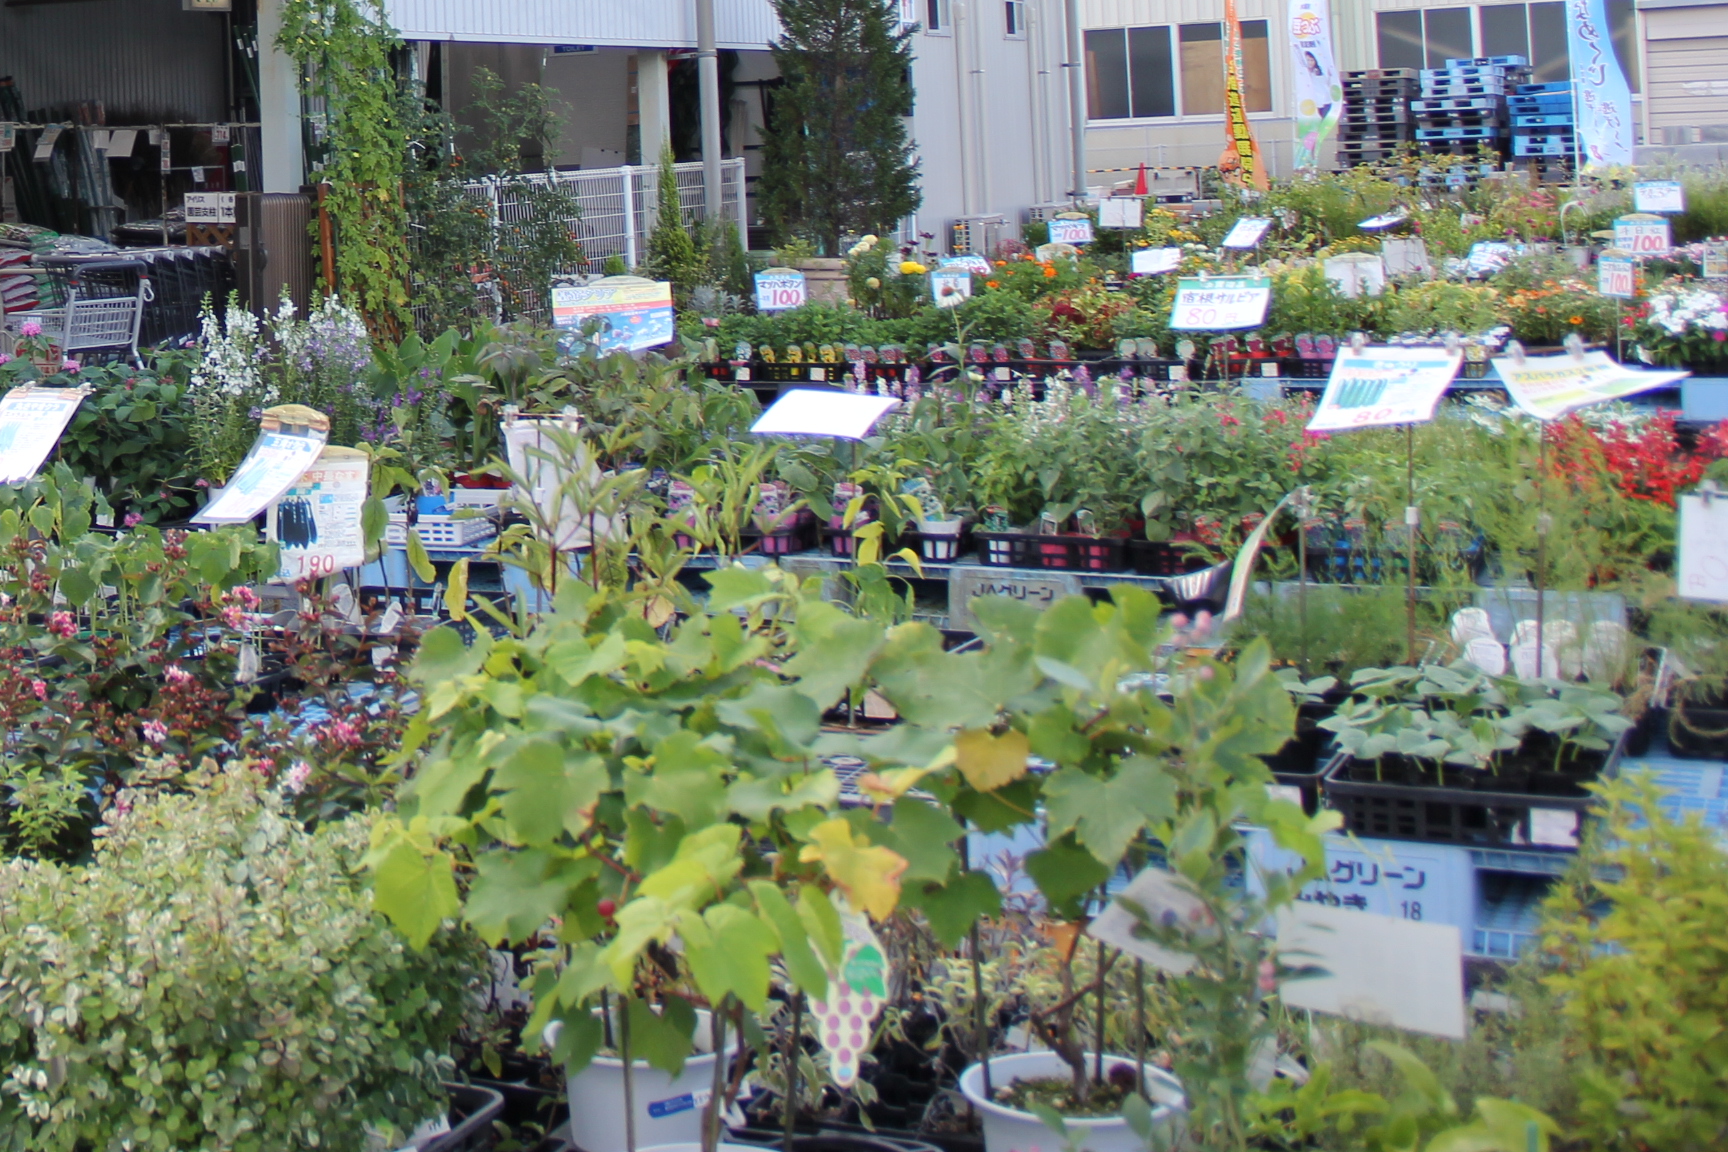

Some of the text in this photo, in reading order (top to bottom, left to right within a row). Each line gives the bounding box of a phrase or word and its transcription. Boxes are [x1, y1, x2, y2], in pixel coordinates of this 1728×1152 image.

[772, 289, 801, 306] 100
[1181, 291, 1260, 304] 宿根サルビア
[297, 554, 335, 574] 190
[1401, 900, 1422, 920] 18
